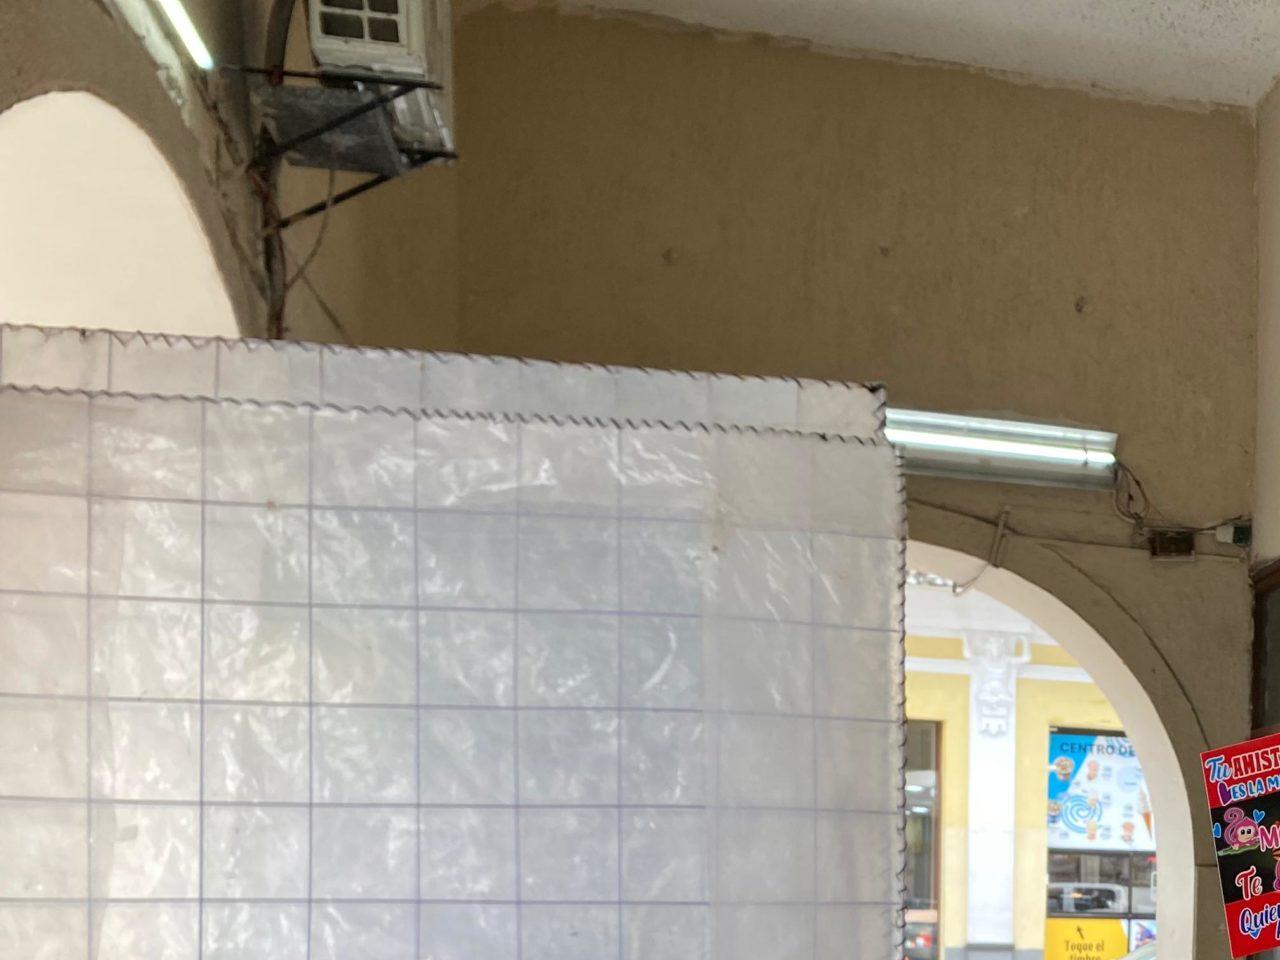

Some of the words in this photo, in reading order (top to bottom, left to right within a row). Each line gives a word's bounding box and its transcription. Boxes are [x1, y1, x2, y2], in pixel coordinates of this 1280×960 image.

[1060, 742, 1115, 755] CENTRO
[1206, 757, 1232, 782] Tu
[1231, 783, 1247, 800] ES
[1249, 780, 1265, 796] LA
[1236, 866, 1263, 900] Te
[1065, 940, 1094, 954] Toque
[1096, 940, 1105, 951] el
